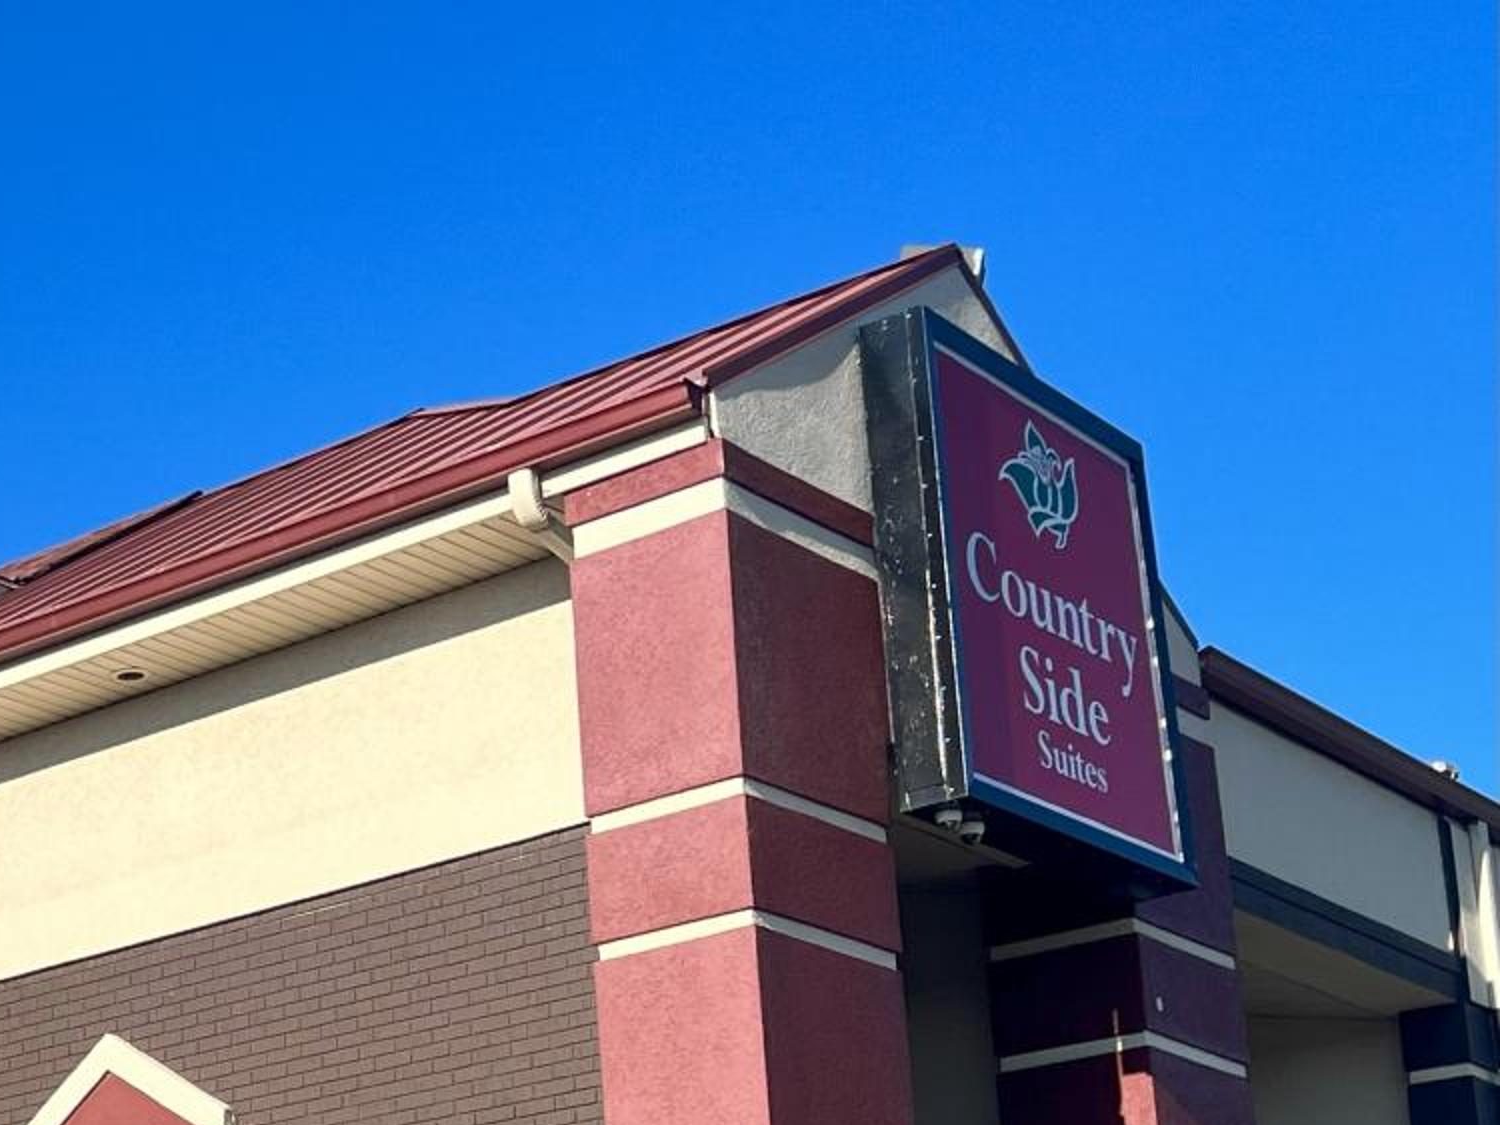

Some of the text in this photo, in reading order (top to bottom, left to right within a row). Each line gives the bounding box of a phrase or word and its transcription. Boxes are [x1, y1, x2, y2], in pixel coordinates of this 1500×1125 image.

[965, 531, 1138, 697] Country
[1019, 645, 1112, 745] Side
[1037, 731, 1109, 794] Suites
